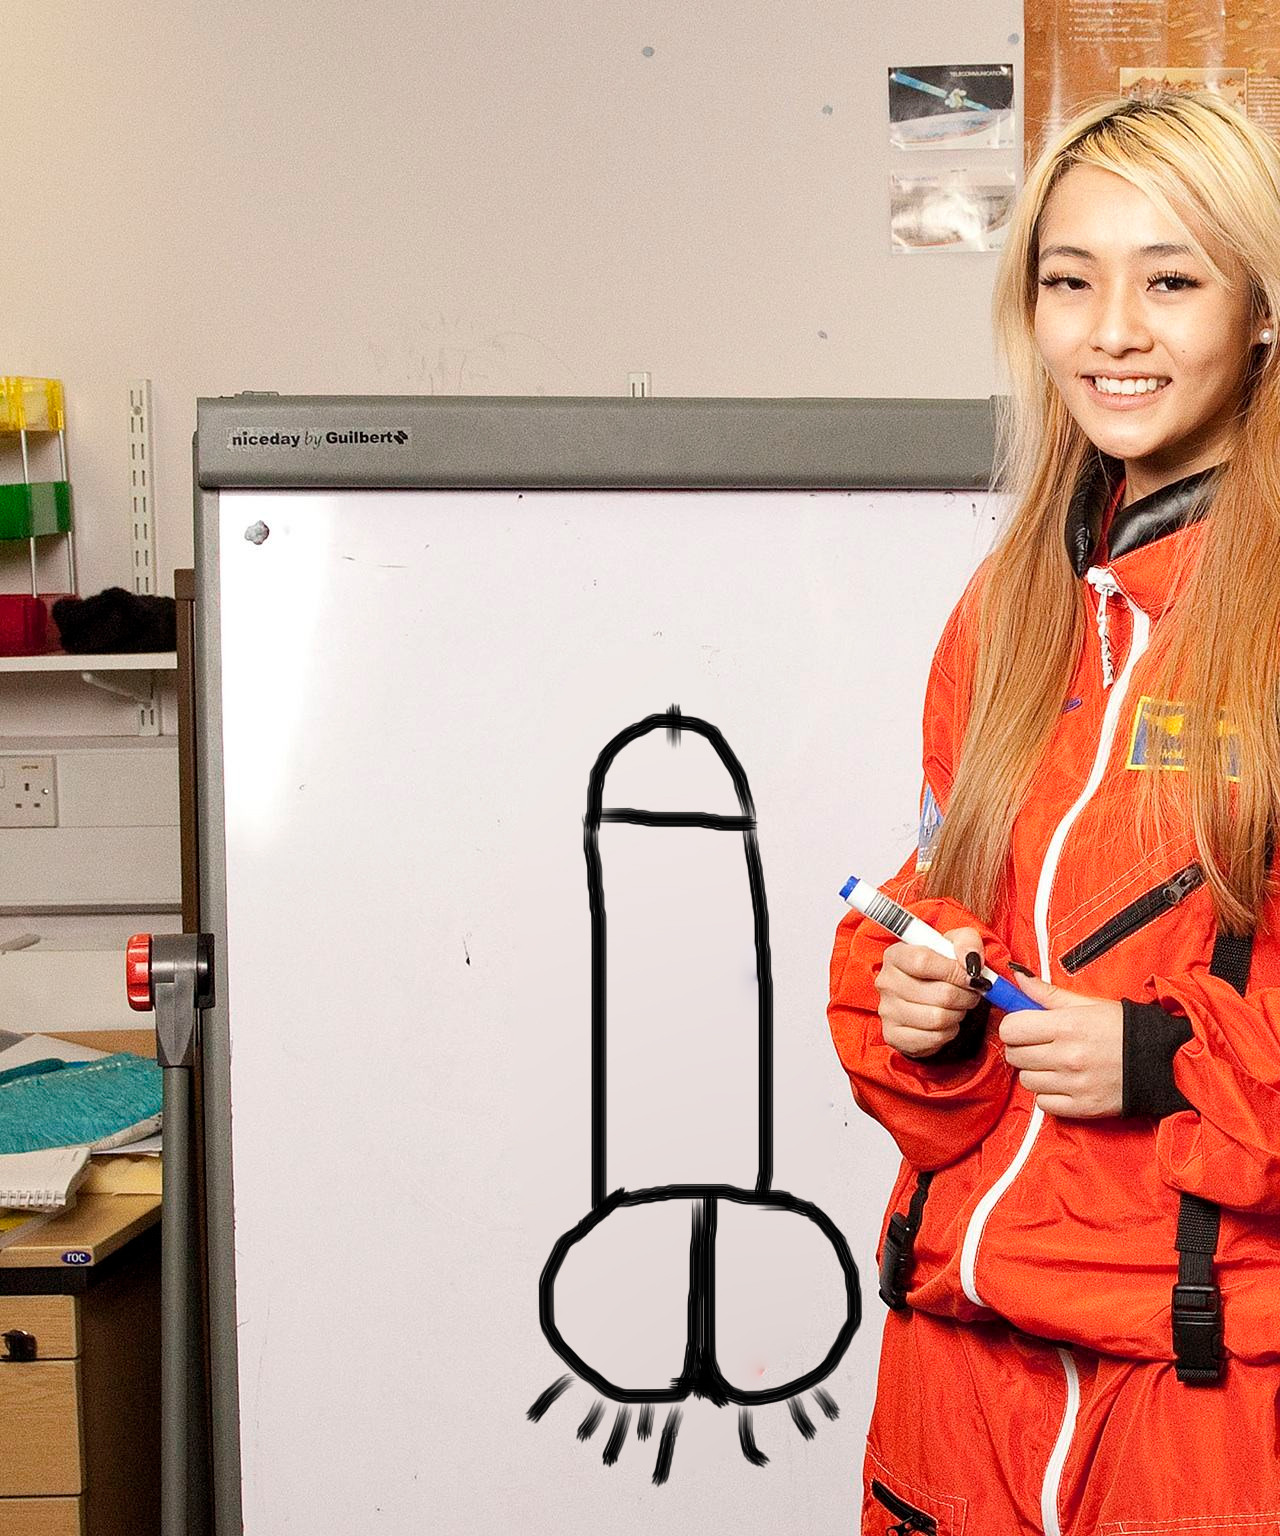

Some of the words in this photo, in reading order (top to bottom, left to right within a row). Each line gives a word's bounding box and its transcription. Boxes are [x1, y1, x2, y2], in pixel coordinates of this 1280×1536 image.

[232, 431, 300, 447] niceday
[304, 431, 323, 449] by
[325, 430, 393, 445] Guilbert
[66, 1252, 86, 1263] roc
